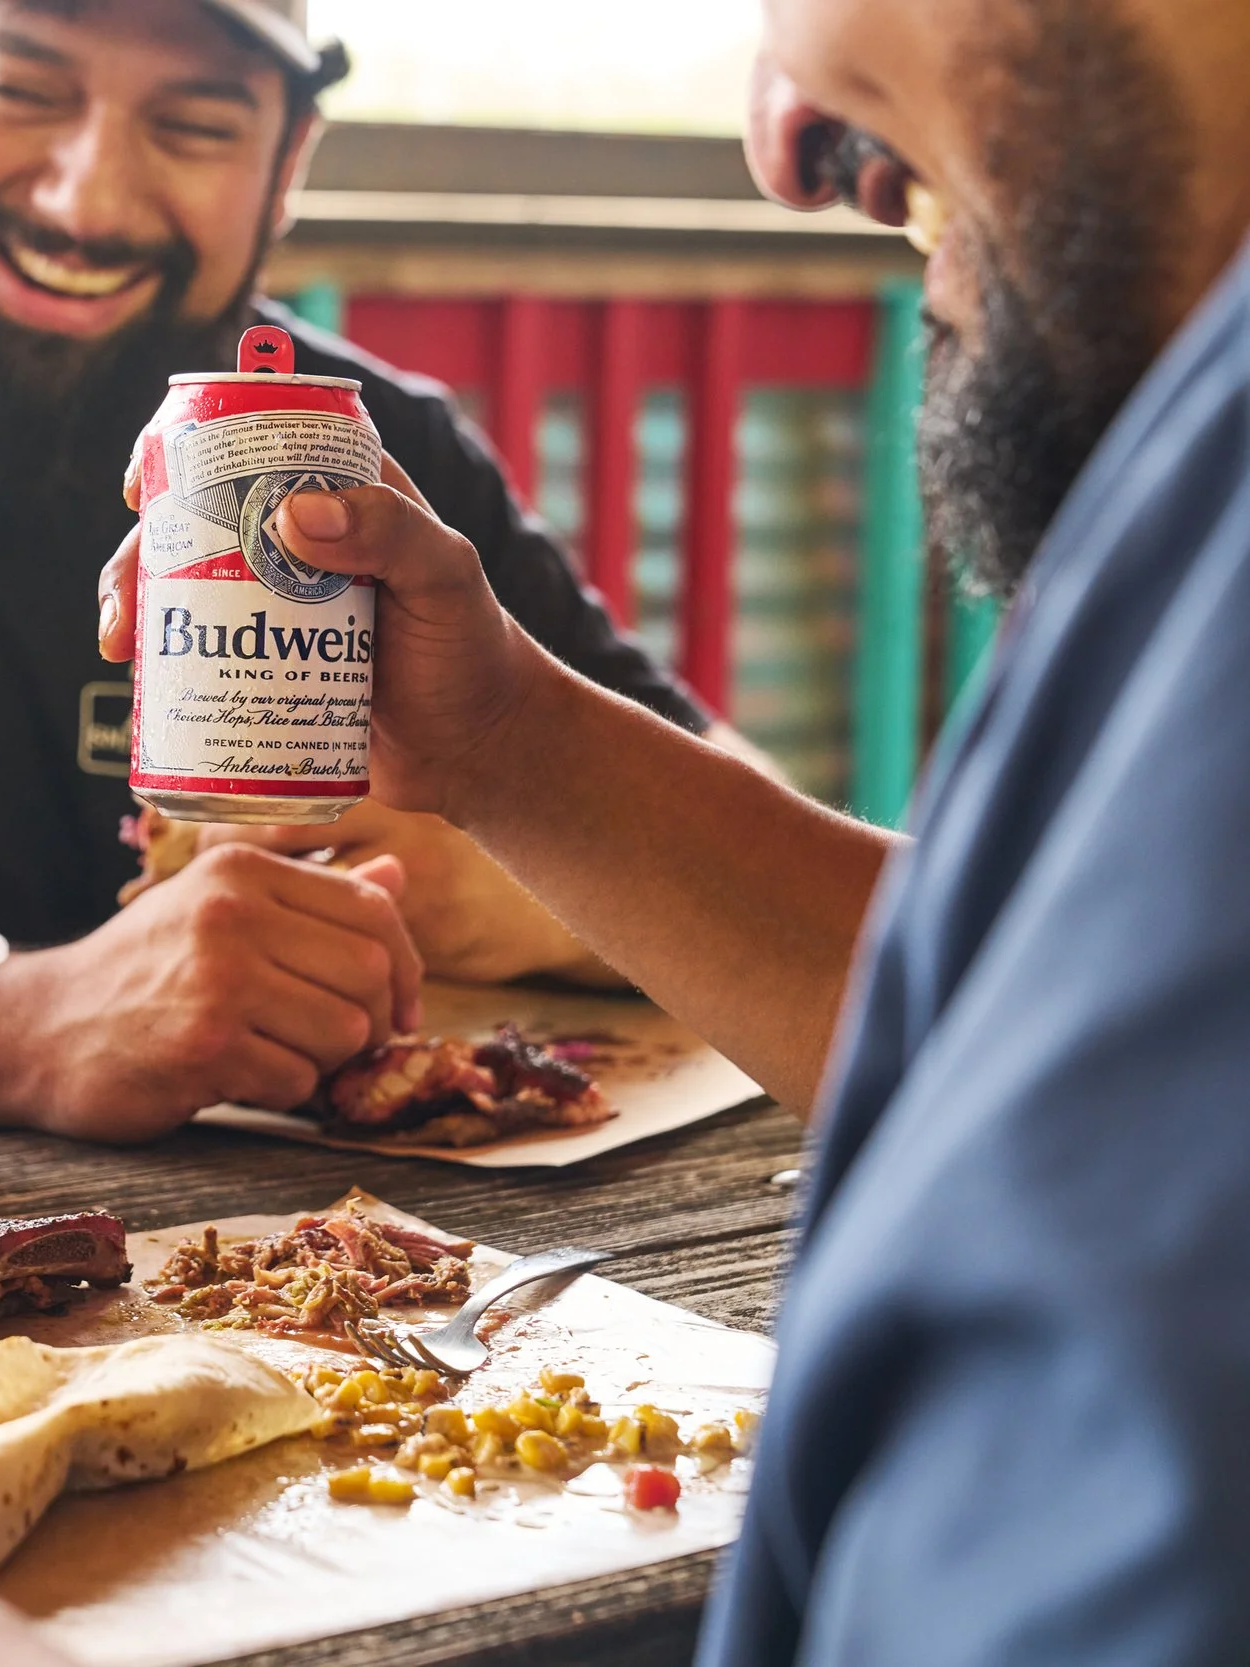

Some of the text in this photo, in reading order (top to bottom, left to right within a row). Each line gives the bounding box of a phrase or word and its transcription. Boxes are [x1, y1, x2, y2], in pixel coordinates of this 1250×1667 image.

[208, 433, 220, 441] the
[221, 425, 253, 439] famous
[255, 421, 300, 431] Budweiser
[320, 422, 332, 430] We
[213, 439, 236, 451] other
[238, 434, 269, 445] brewer
[299, 432, 320, 440] costs
[332, 435, 351, 445] much
[227, 442, 279, 459] Beechwood
[309, 443, 345, 453] produces
[213, 457, 265, 474] drinkability
[268, 455, 284, 464] you
[286, 453, 302, 461] will
[303, 453, 320, 463] find
[321, 454, 330, 463] in
[341, 459, 359, 469] other
[267, 485, 289, 509] UNITED
[269, 548, 283, 565] THE
[211, 568, 241, 578] SINCE
[293, 585, 324, 596] AMERICA
[158, 607, 375, 664] Budweis
[218, 668, 275, 681] KING
[284, 670, 312, 681] OF
[178, 687, 229, 703] Brewed
[230, 690, 248, 710] by
[251, 695, 276, 705] our
[277, 692, 326, 712] original
[166, 707, 214, 723] Choicest
[250, 709, 291, 726] Rice
[290, 713, 319, 727] and
[318, 710, 347, 728] Best
[204, 738, 253, 748] BREWED
[257, 740, 282, 749] AND
[286, 741, 330, 750] CANNED
[332, 741, 341, 751] IN
[343, 741, 357, 751] THE
